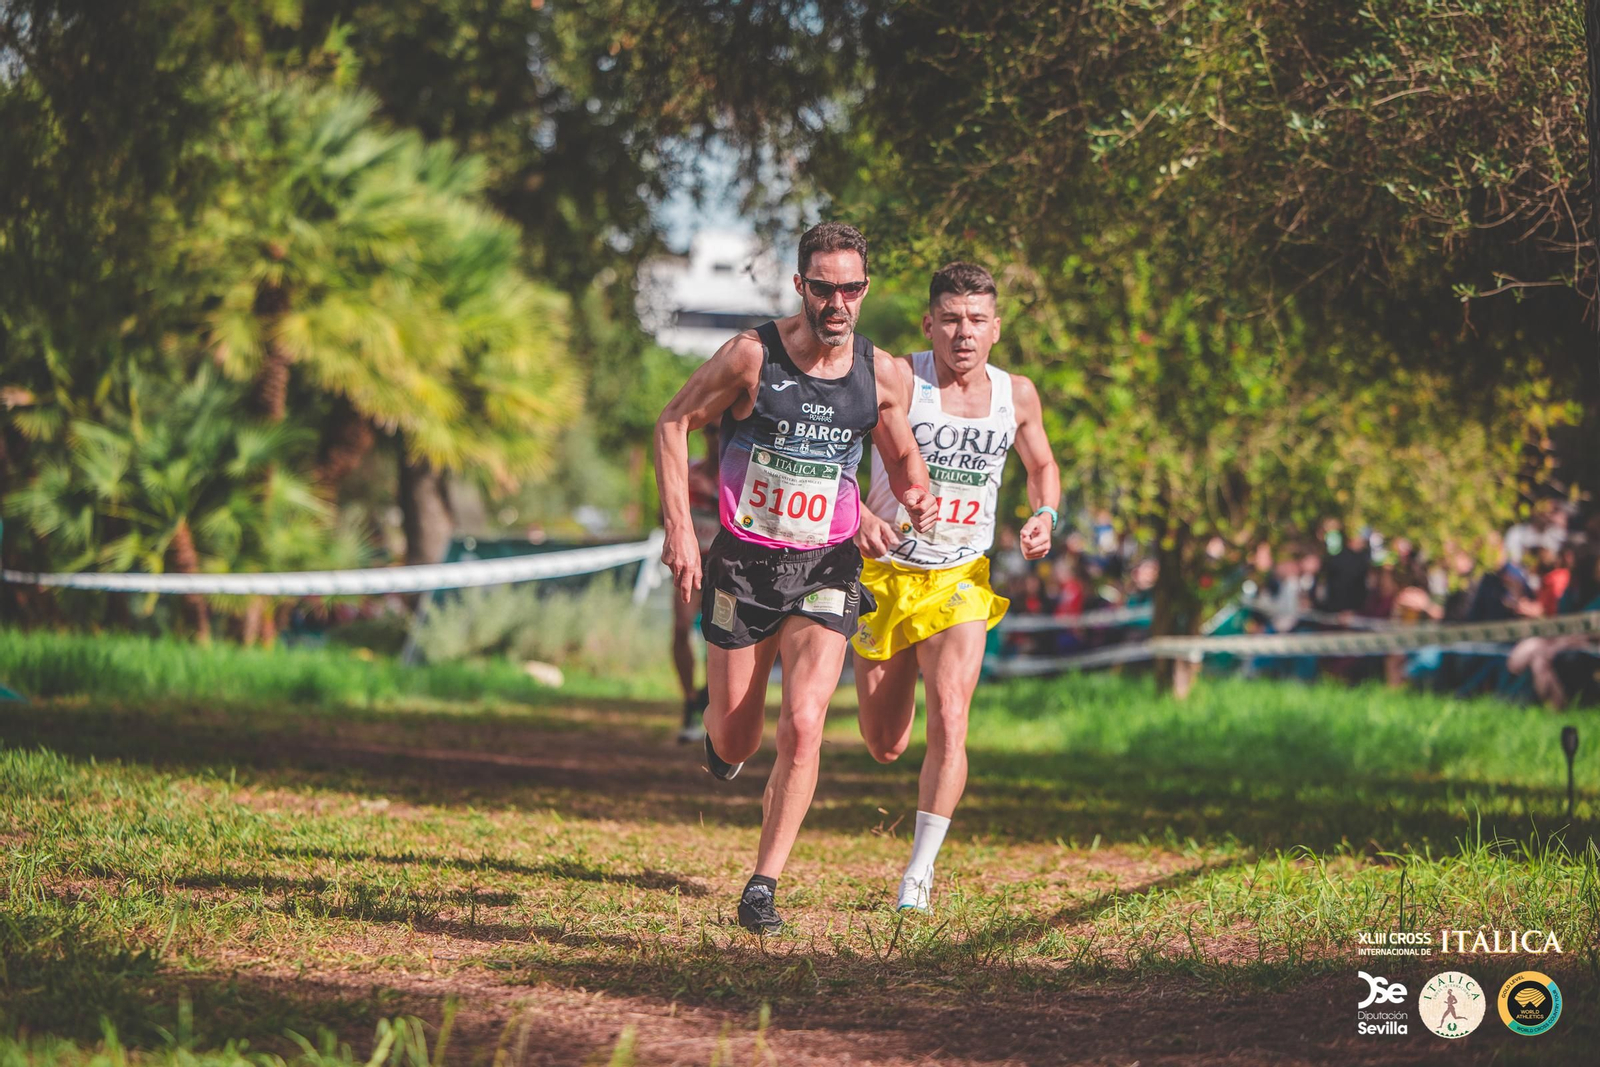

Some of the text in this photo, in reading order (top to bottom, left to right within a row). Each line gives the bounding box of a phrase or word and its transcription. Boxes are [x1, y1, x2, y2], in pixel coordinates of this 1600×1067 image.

[778, 420, 853, 443] O BARCO
[912, 422, 1009, 457] CORIA
[927, 450, 987, 471] del Río
[748, 479, 827, 522] 5100
